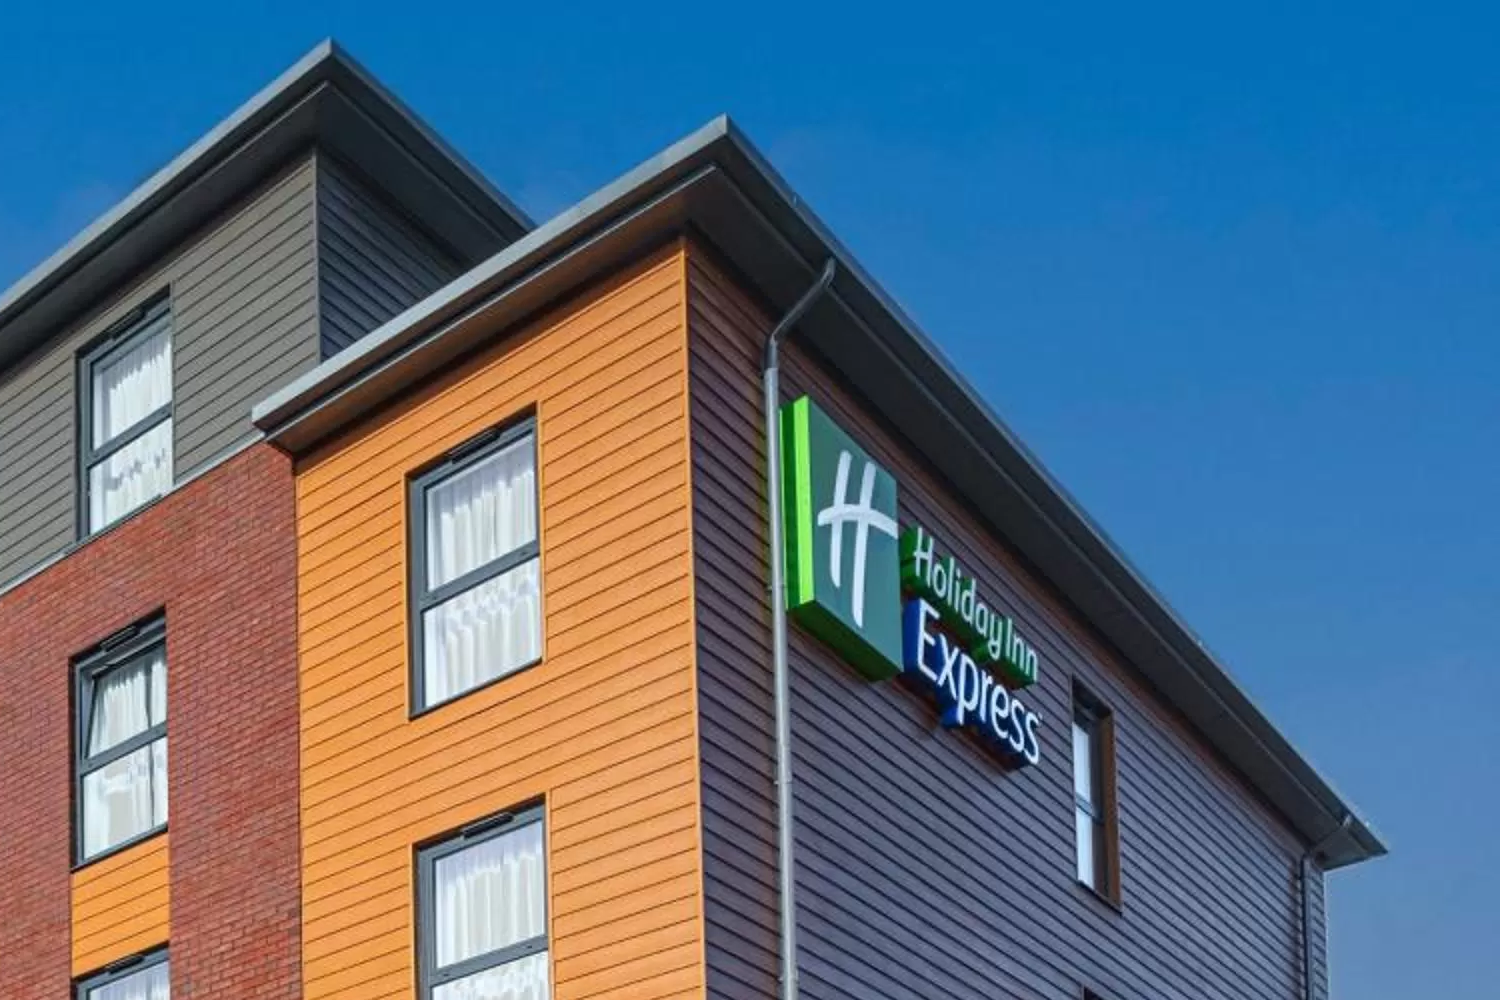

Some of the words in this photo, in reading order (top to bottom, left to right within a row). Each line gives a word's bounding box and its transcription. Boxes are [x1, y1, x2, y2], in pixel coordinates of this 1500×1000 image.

[913, 526, 1002, 660] Holiday
[1004, 617, 1038, 682] Inn
[917, 598, 1041, 765] Express
